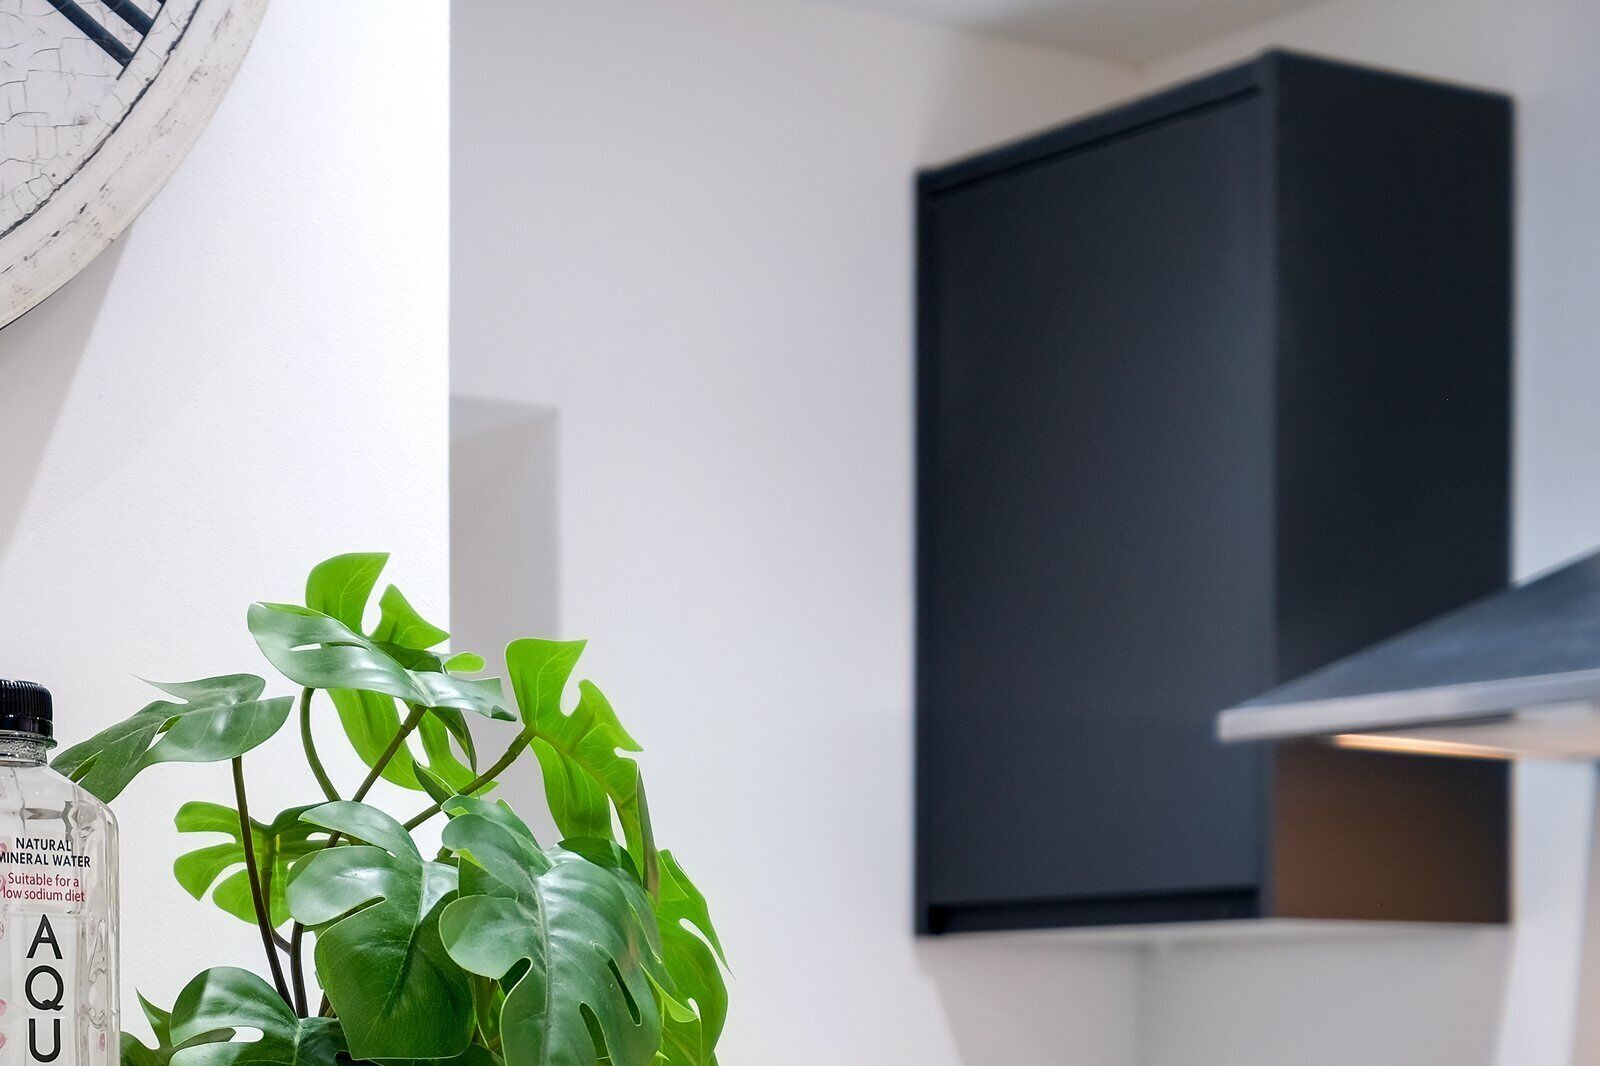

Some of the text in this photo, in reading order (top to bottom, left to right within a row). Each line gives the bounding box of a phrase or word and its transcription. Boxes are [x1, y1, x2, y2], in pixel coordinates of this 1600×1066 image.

[16, 837, 72, 852] NATURAL
[52, 854, 91, 868] WATER
[8, 872, 79, 888] Suitable for a
[3, 886, 85, 902] low sodium diet
